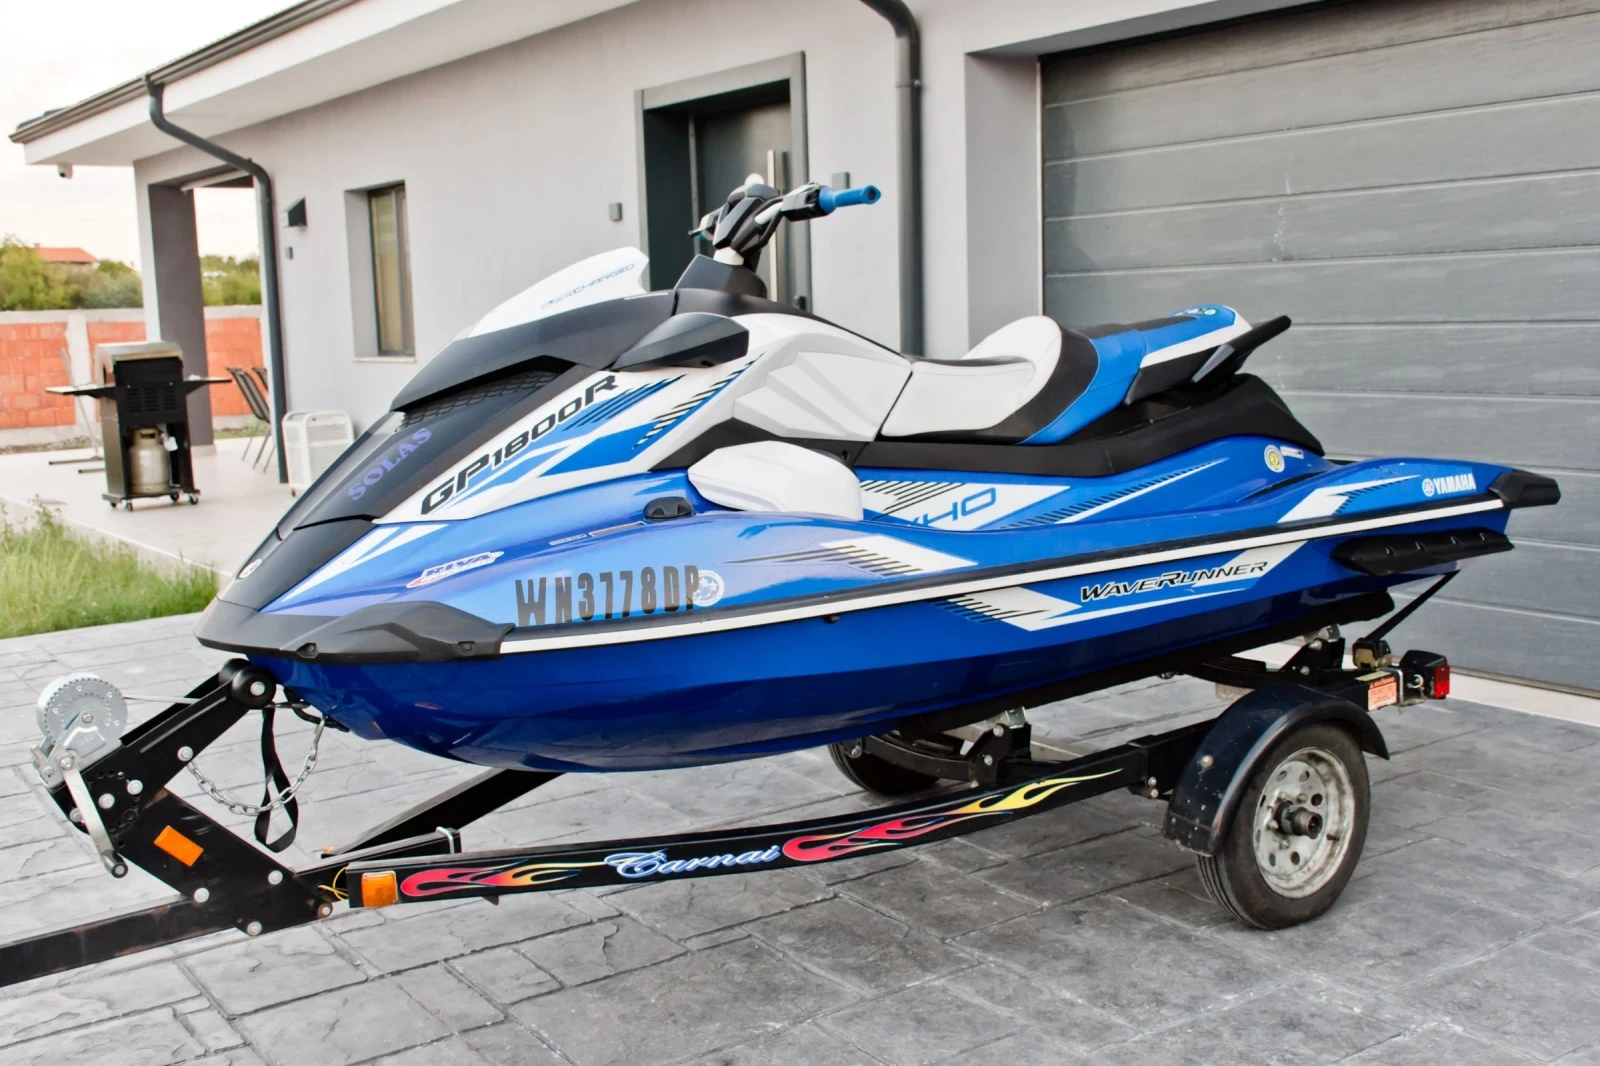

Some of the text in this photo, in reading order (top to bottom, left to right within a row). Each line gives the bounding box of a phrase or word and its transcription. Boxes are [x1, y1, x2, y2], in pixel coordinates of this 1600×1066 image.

[541, 263, 635, 310] CHARGED
[348, 427, 432, 500] SOLAS
[420, 374, 619, 515] GP1800R
[1434, 473, 1476, 494] YAMAHA
[425, 554, 491, 577] RIVA
[515, 565, 700, 628] WN3778DP
